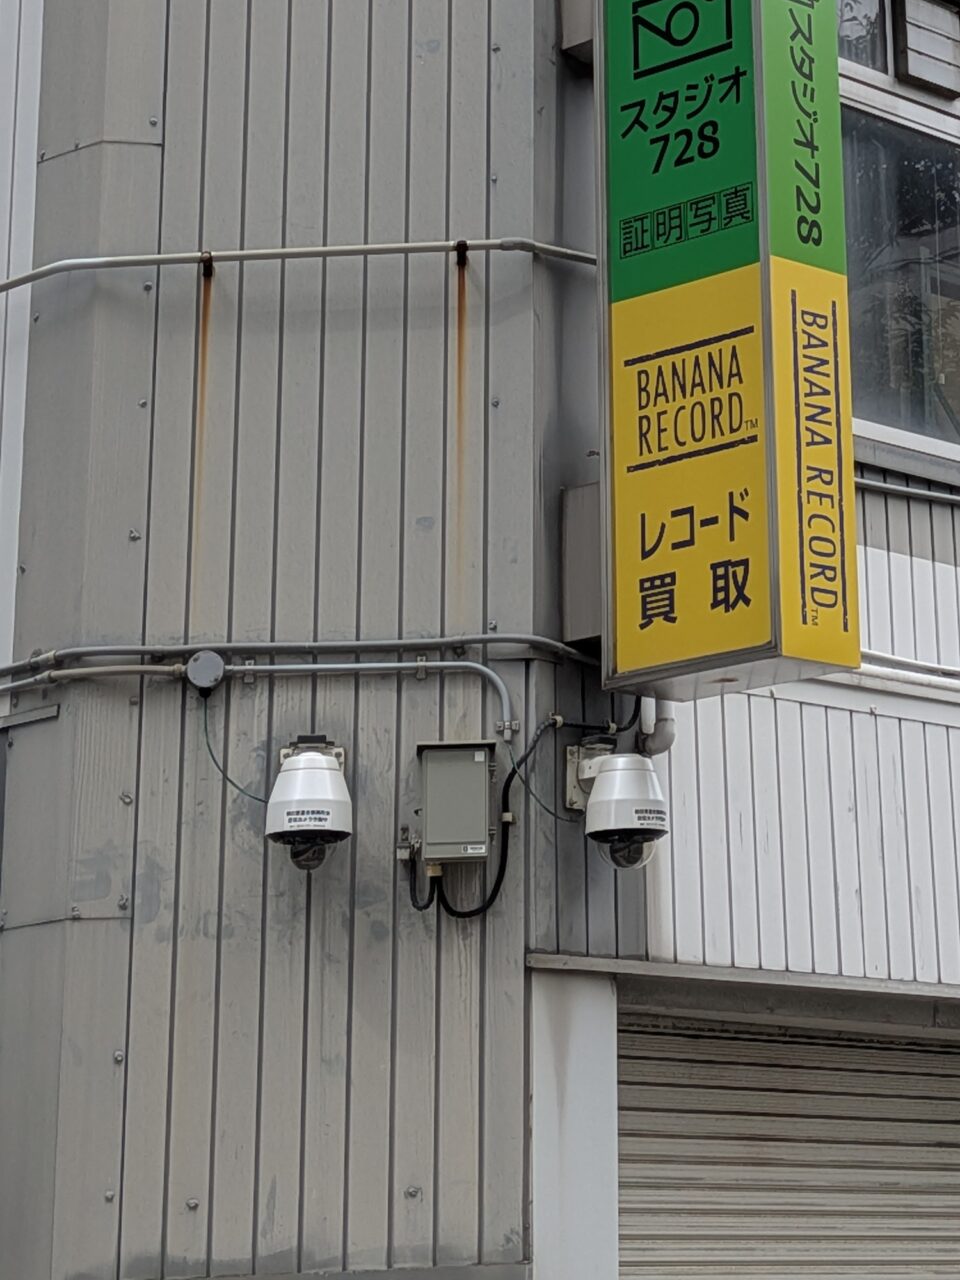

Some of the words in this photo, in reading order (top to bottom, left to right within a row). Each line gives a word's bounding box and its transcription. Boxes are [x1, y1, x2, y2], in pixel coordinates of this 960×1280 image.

[619, 65, 749, 140] スタジオ
[648, 120, 721, 176] 728
[619, 181, 754, 259] 証明写真
[636, 344, 745, 412] BANANA
[800, 308, 834, 448] BANANA
[639, 487, 751, 562] レコード
[638, 557, 753, 631] 買取
